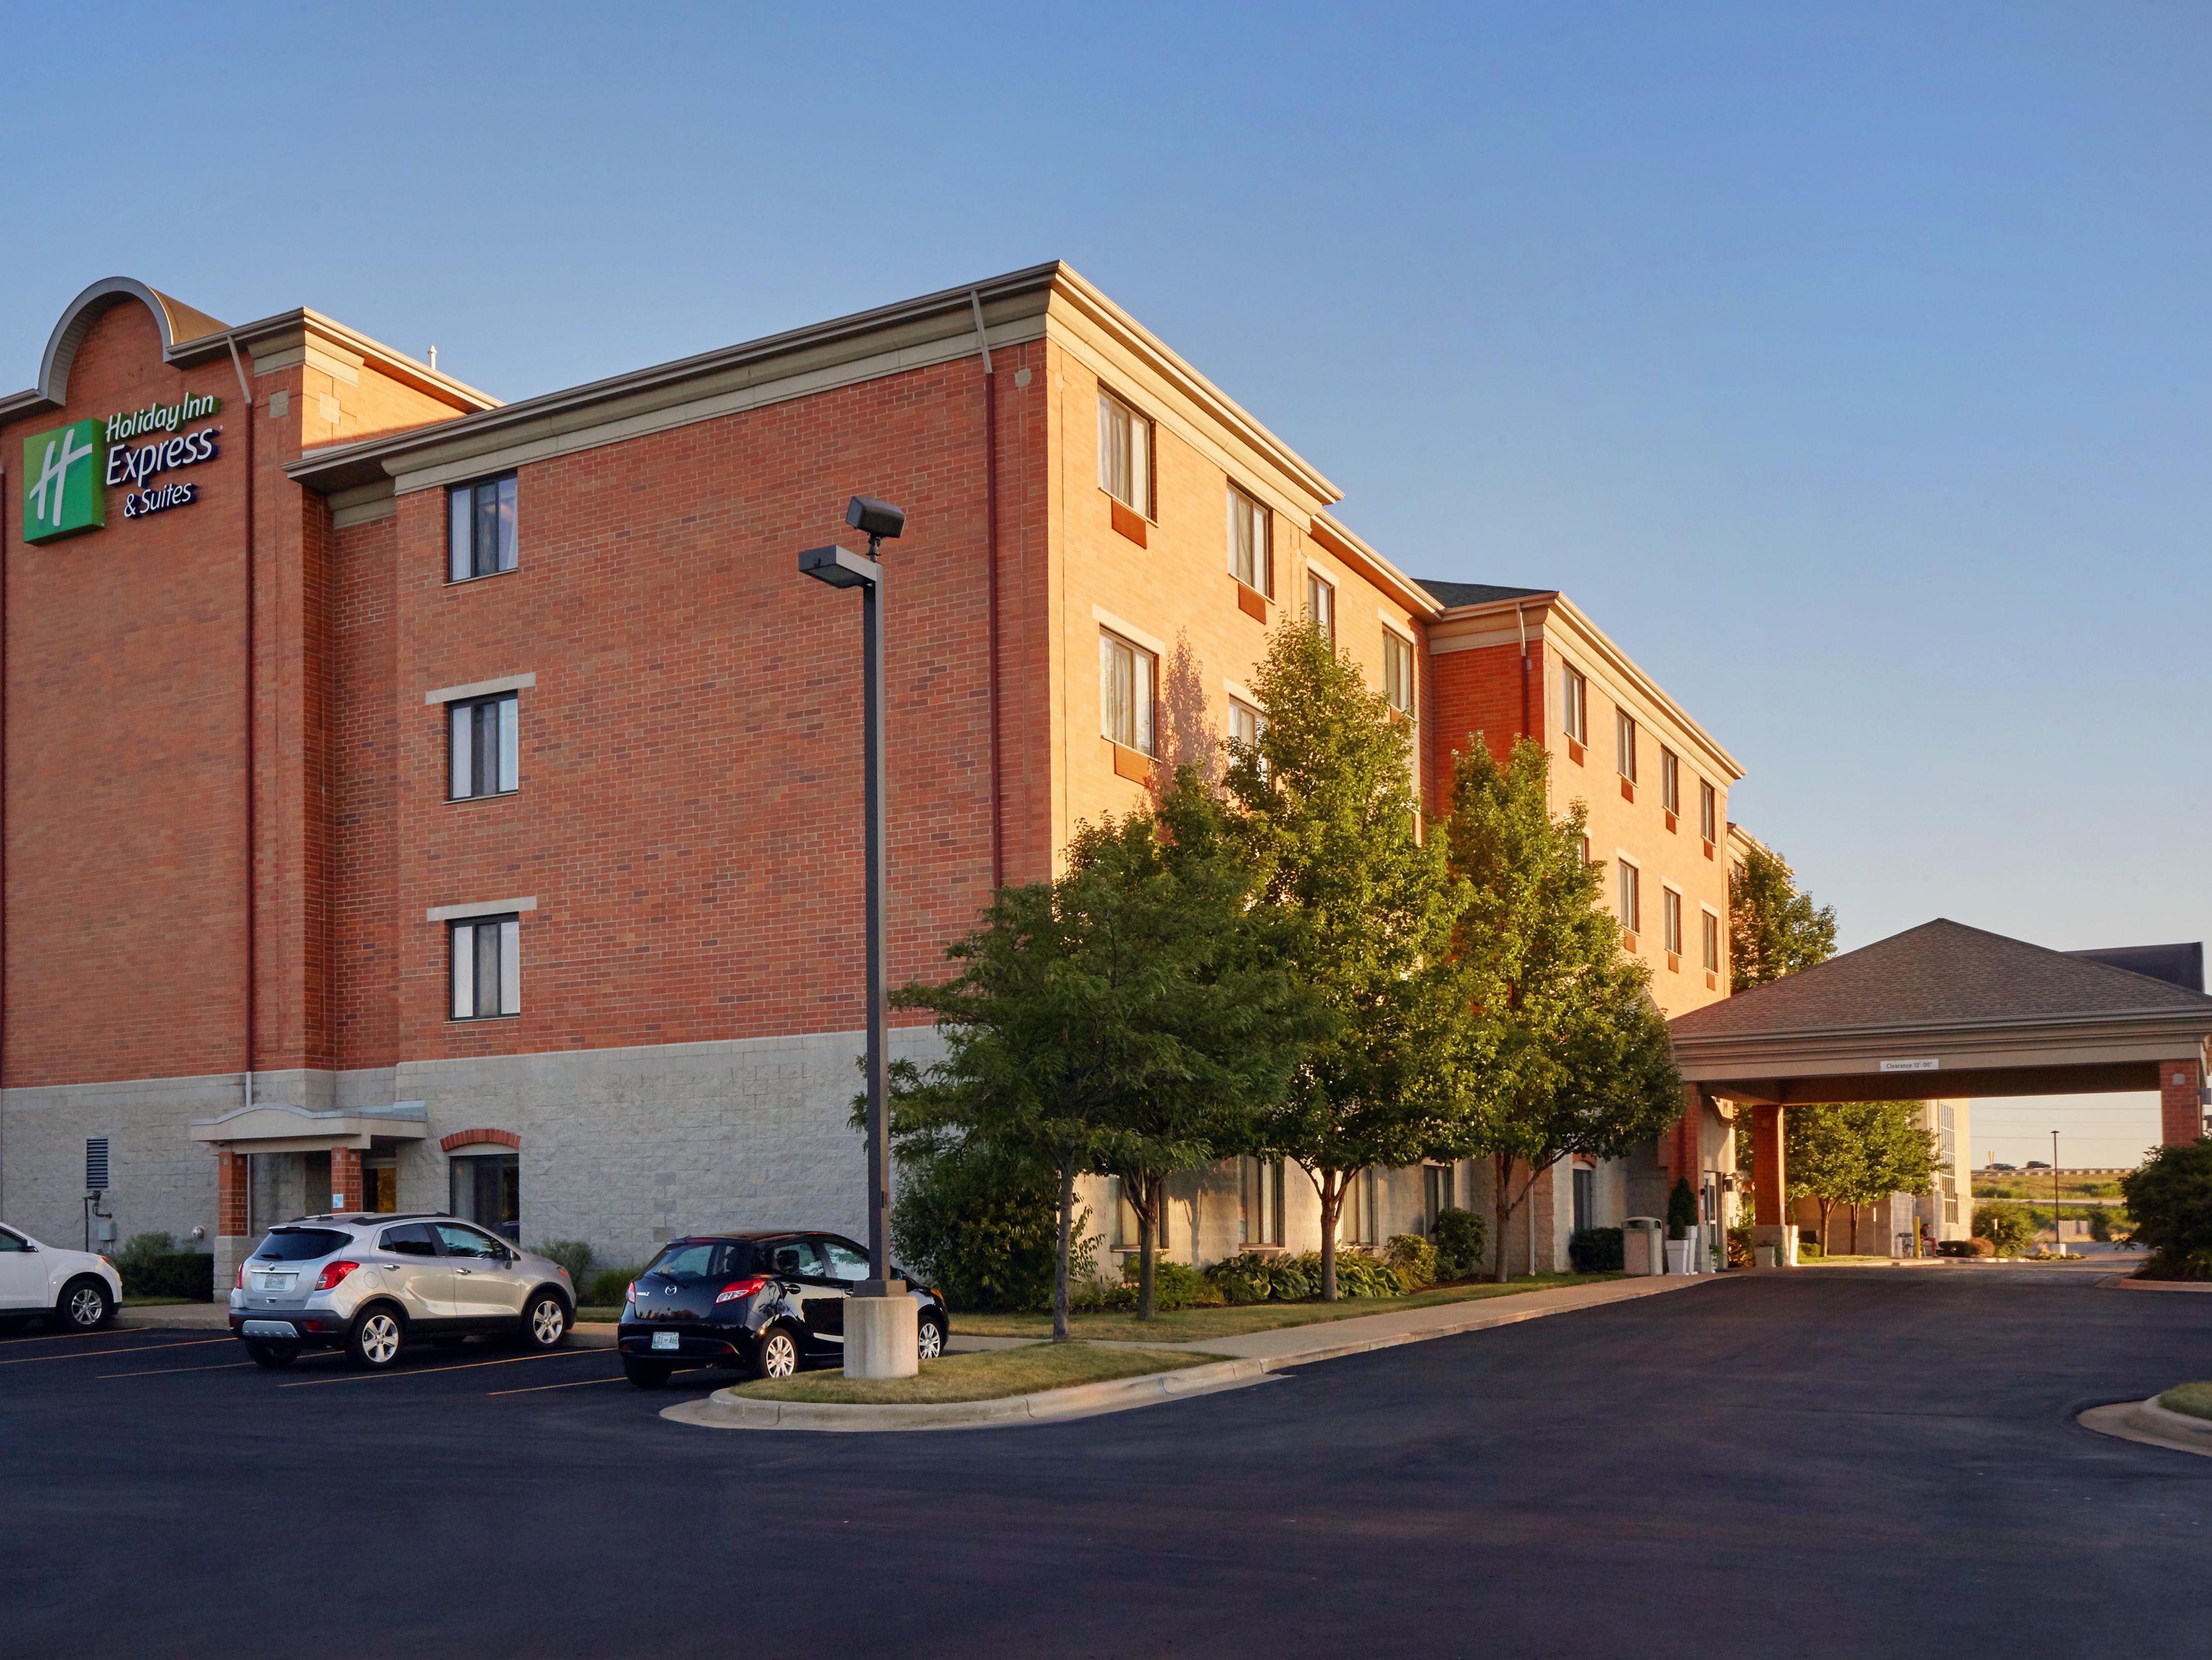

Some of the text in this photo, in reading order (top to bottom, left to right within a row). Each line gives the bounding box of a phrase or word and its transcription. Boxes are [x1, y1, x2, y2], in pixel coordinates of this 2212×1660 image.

[105, 392, 213, 443] Holiday Inn
[106, 428, 213, 488] Express
[123, 482, 192, 518] & Suites
